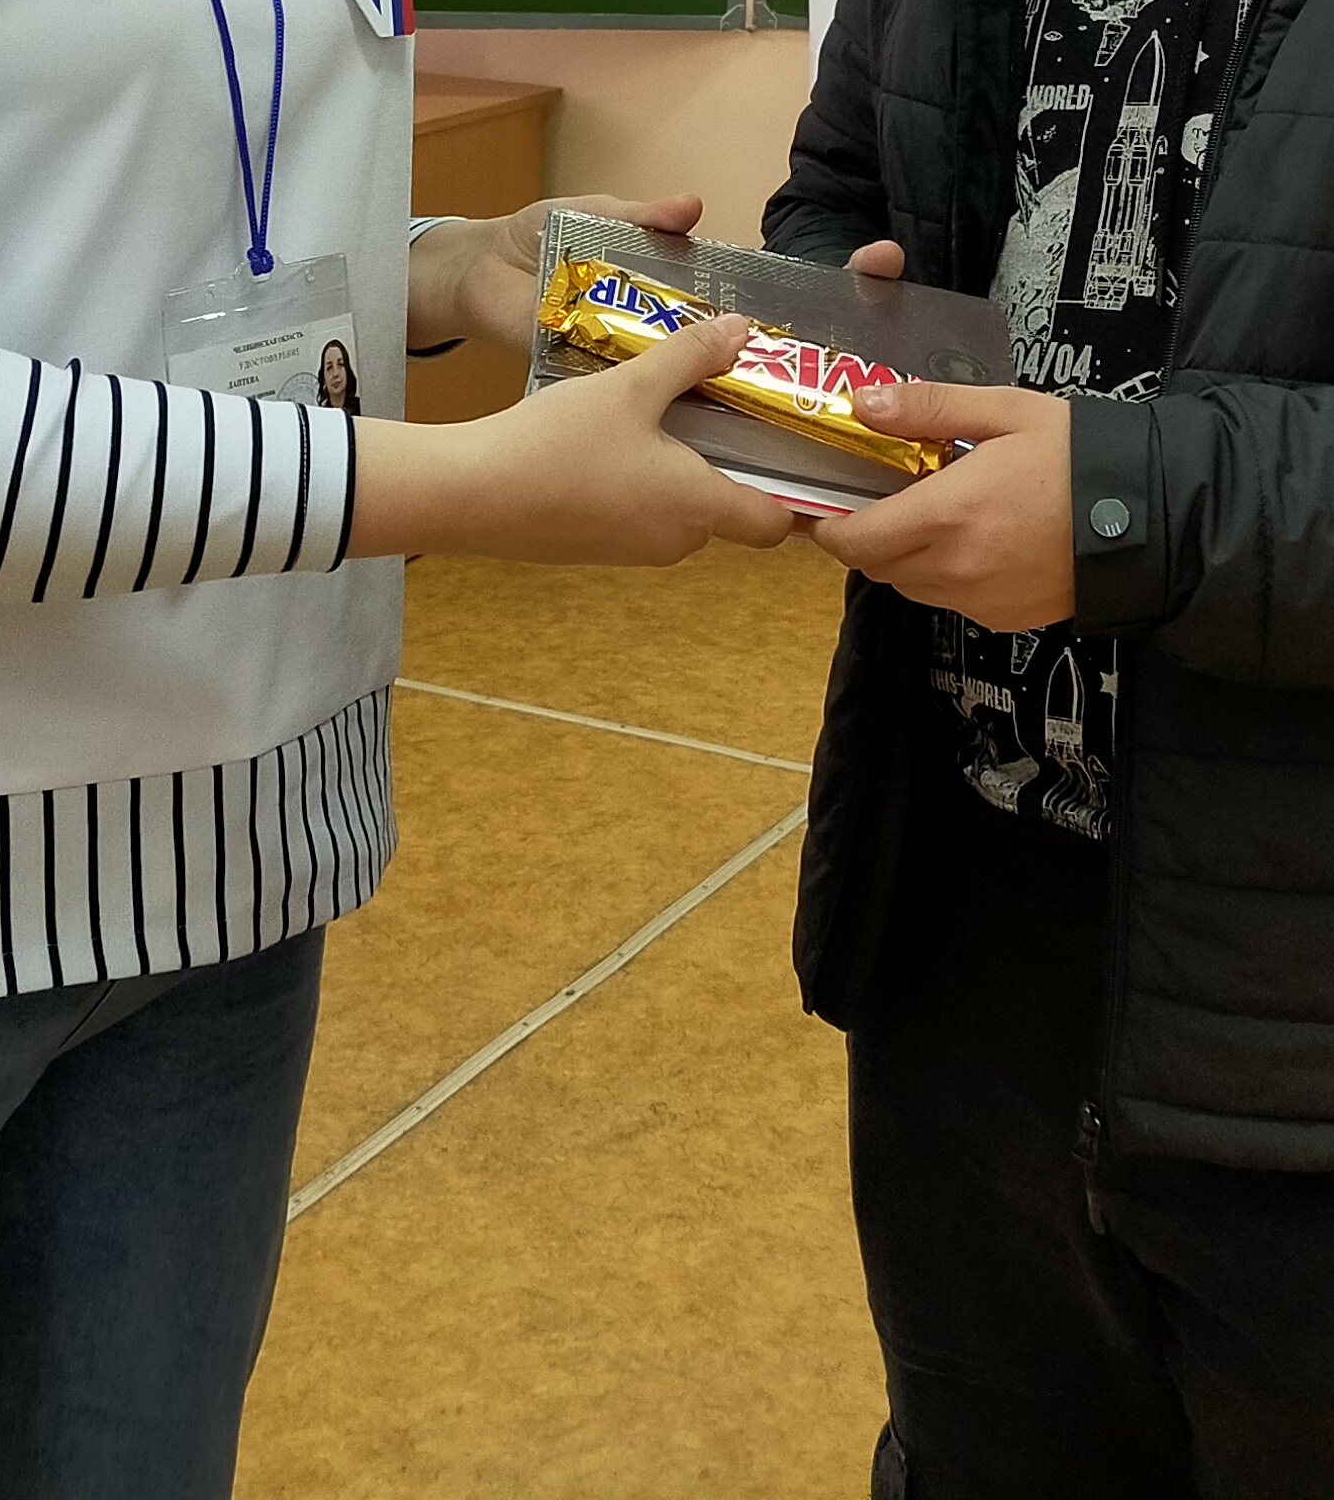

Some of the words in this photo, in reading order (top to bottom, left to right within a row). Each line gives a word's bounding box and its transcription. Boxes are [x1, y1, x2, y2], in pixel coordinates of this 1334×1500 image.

[1026, 84, 1091, 110] WORLD
[586, 276, 685, 335] XTR
[734, 332, 905, 393] WIX
[962, 675, 1012, 713] WORLD
